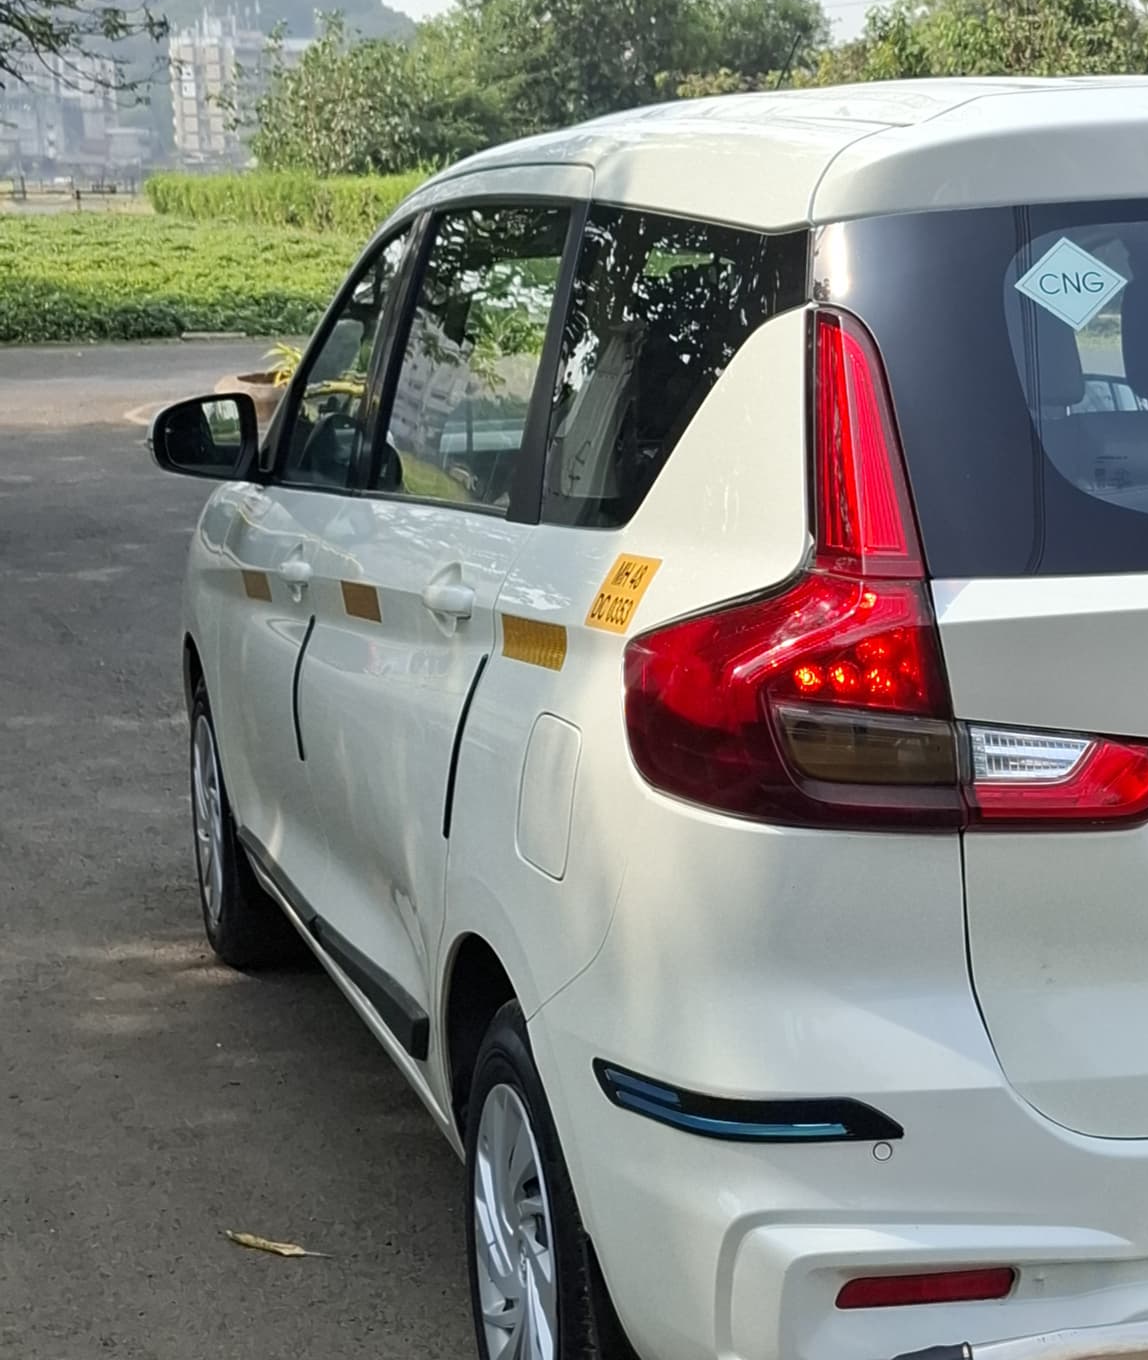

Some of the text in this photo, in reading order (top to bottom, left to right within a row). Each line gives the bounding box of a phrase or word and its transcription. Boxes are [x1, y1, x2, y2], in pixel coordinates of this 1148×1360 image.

[1039, 272, 1105, 295] CNG
[611, 560, 649, 590] MH 48
[590, 592, 634, 626] DC 0353
